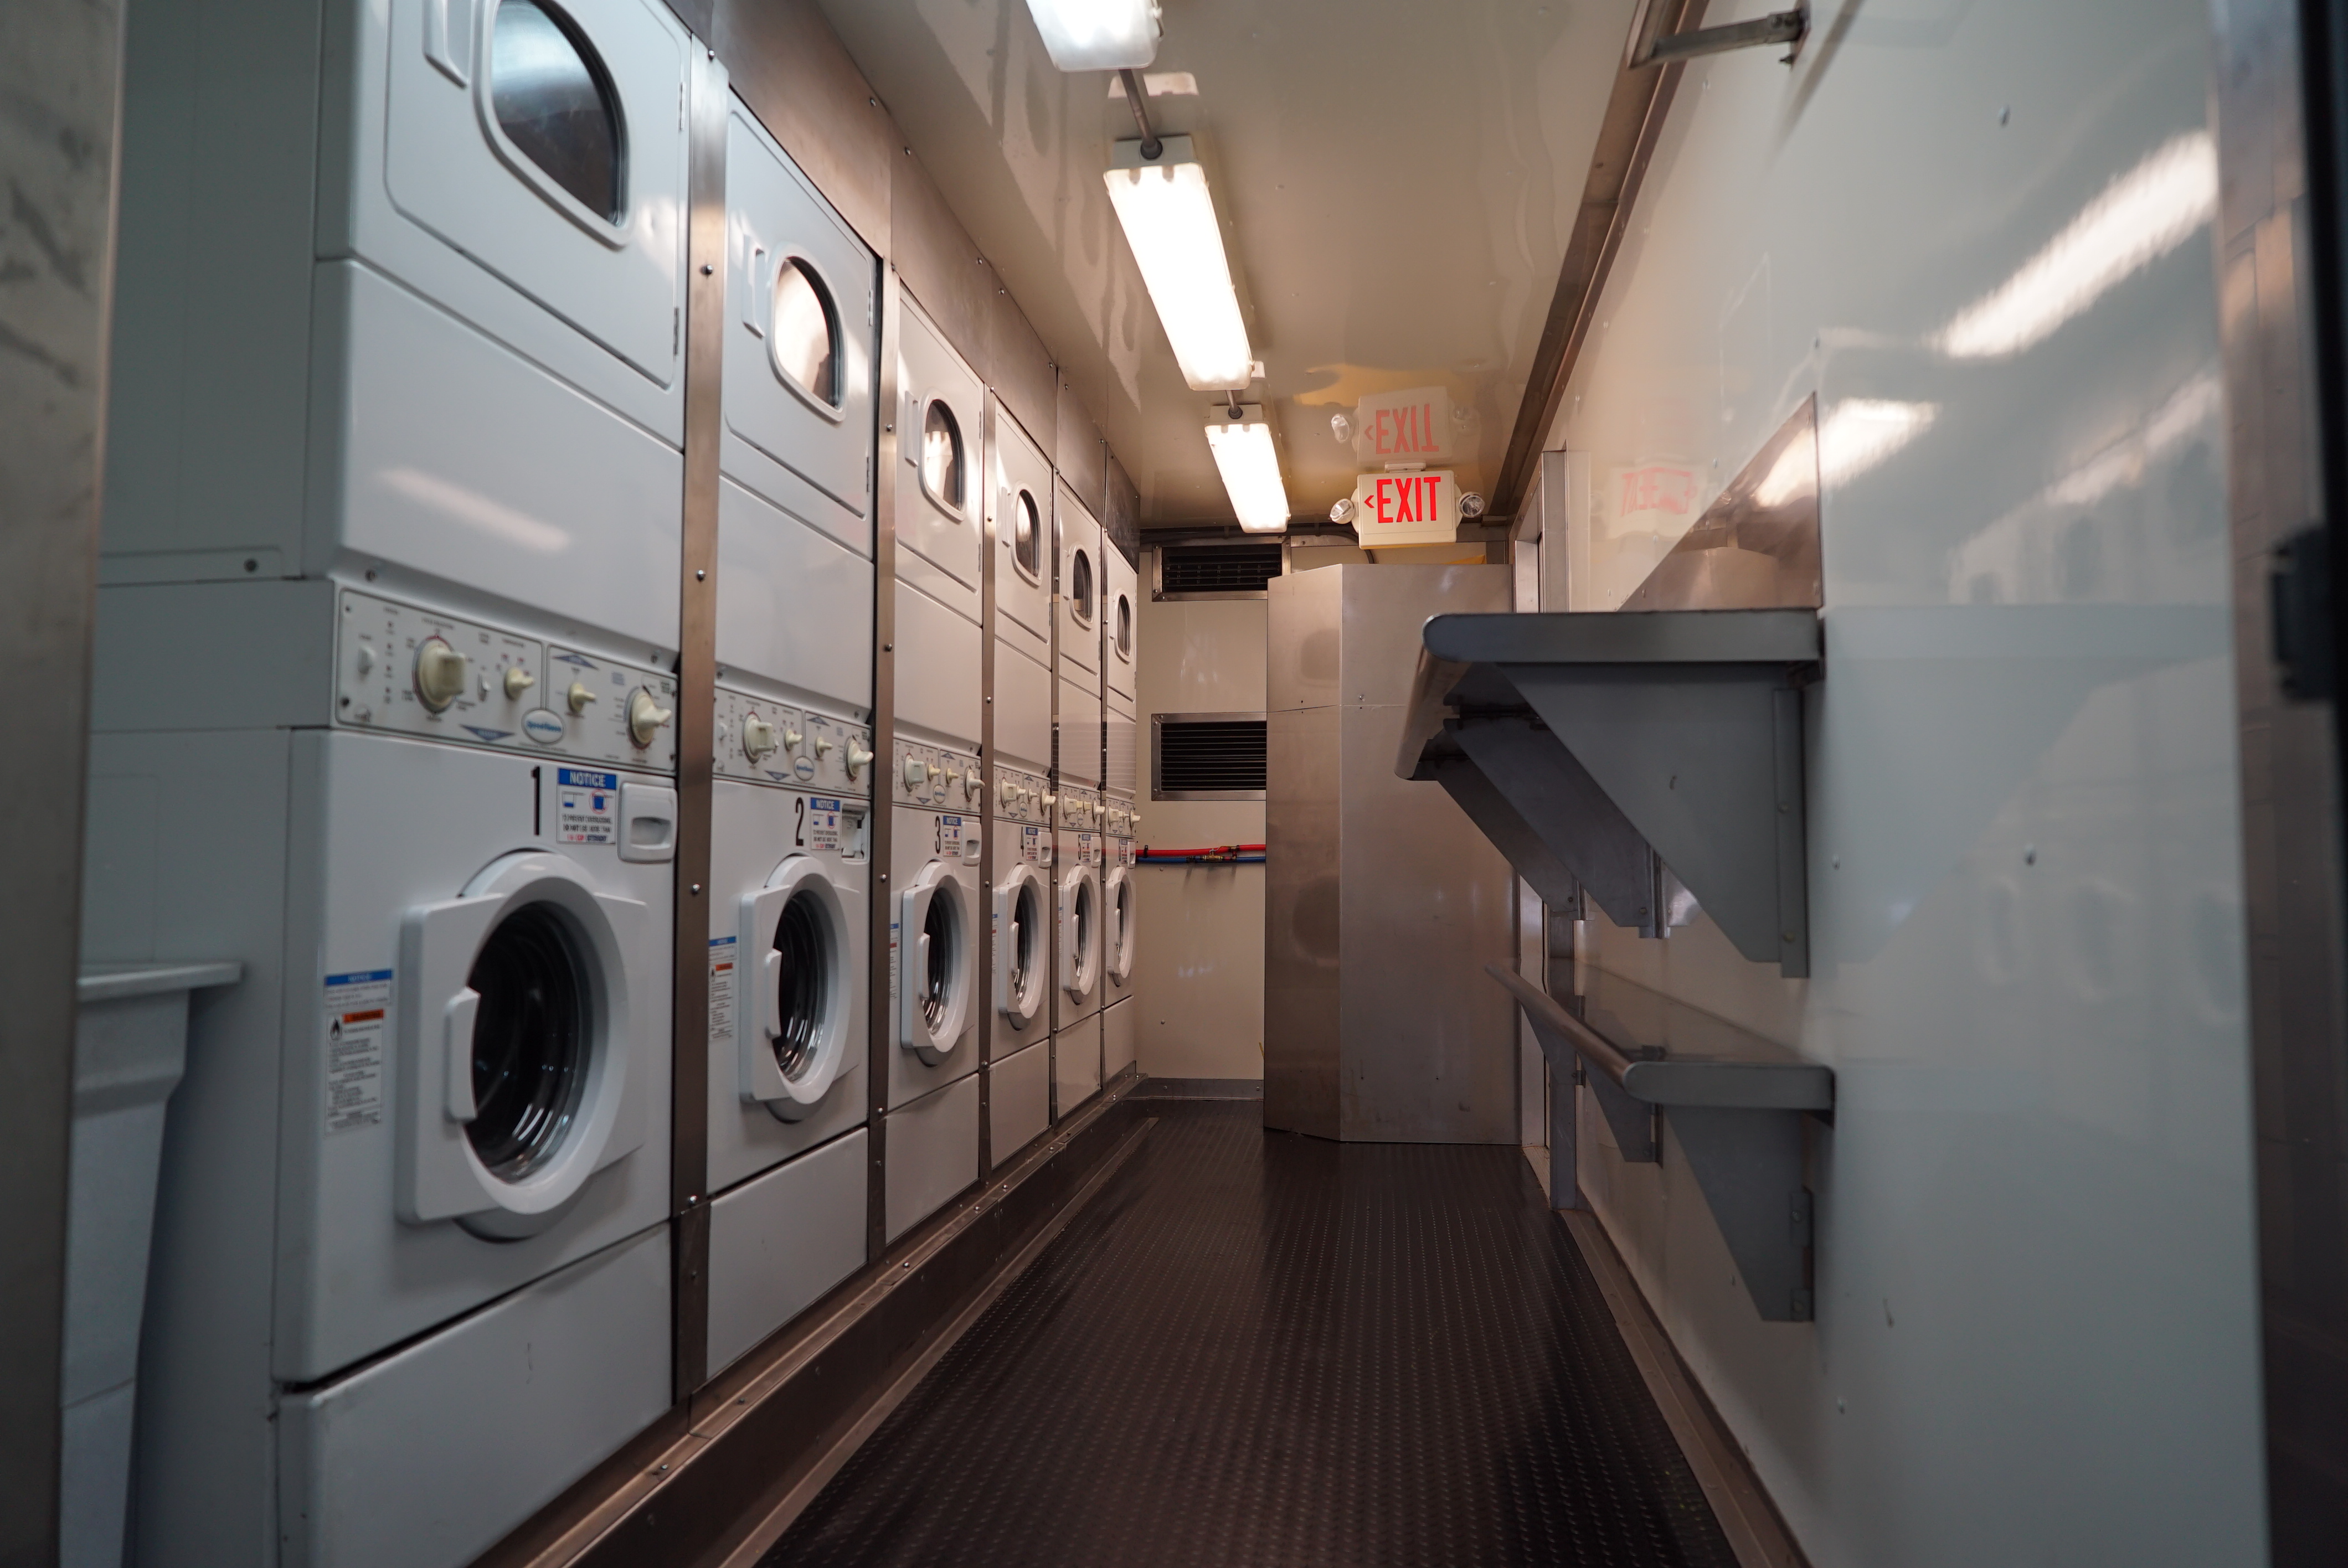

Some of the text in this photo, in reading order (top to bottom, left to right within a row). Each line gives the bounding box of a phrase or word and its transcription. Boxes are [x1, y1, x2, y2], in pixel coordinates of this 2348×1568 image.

[1377, 477, 1440, 523] EXIT
[569, 771, 606, 788] NOTICE
[531, 766, 540, 835] 1
[815, 800, 835, 810] NOTICE
[796, 797, 804, 846] 2
[935, 816, 940, 854] 3
[1021, 826, 1024, 857] 4
[1078, 834, 1081, 860] 5
